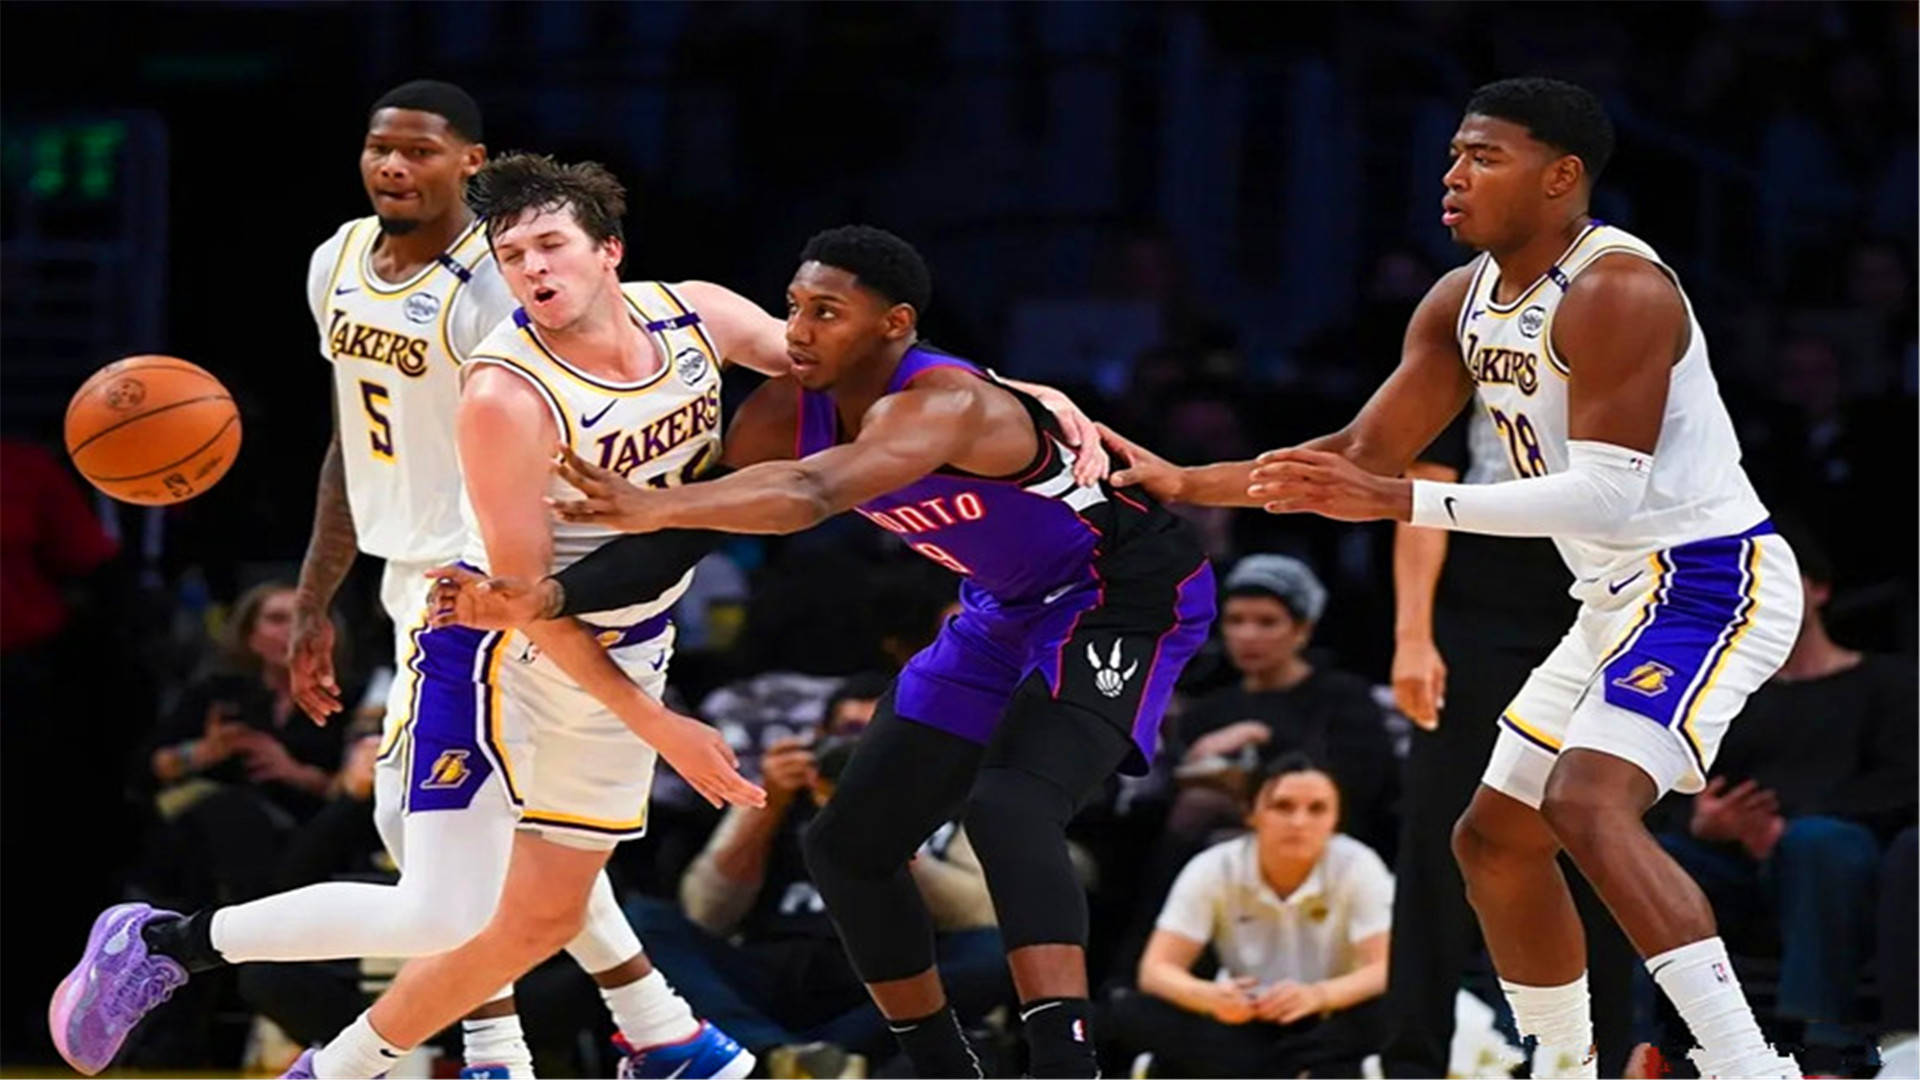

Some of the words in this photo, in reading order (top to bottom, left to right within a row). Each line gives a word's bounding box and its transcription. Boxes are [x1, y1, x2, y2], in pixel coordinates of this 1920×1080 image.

[330, 308, 429, 378] LAKERS
[360, 379, 397, 462] 5
[596, 383, 718, 479] LAKERS
[854, 492, 984, 533] ONTO
